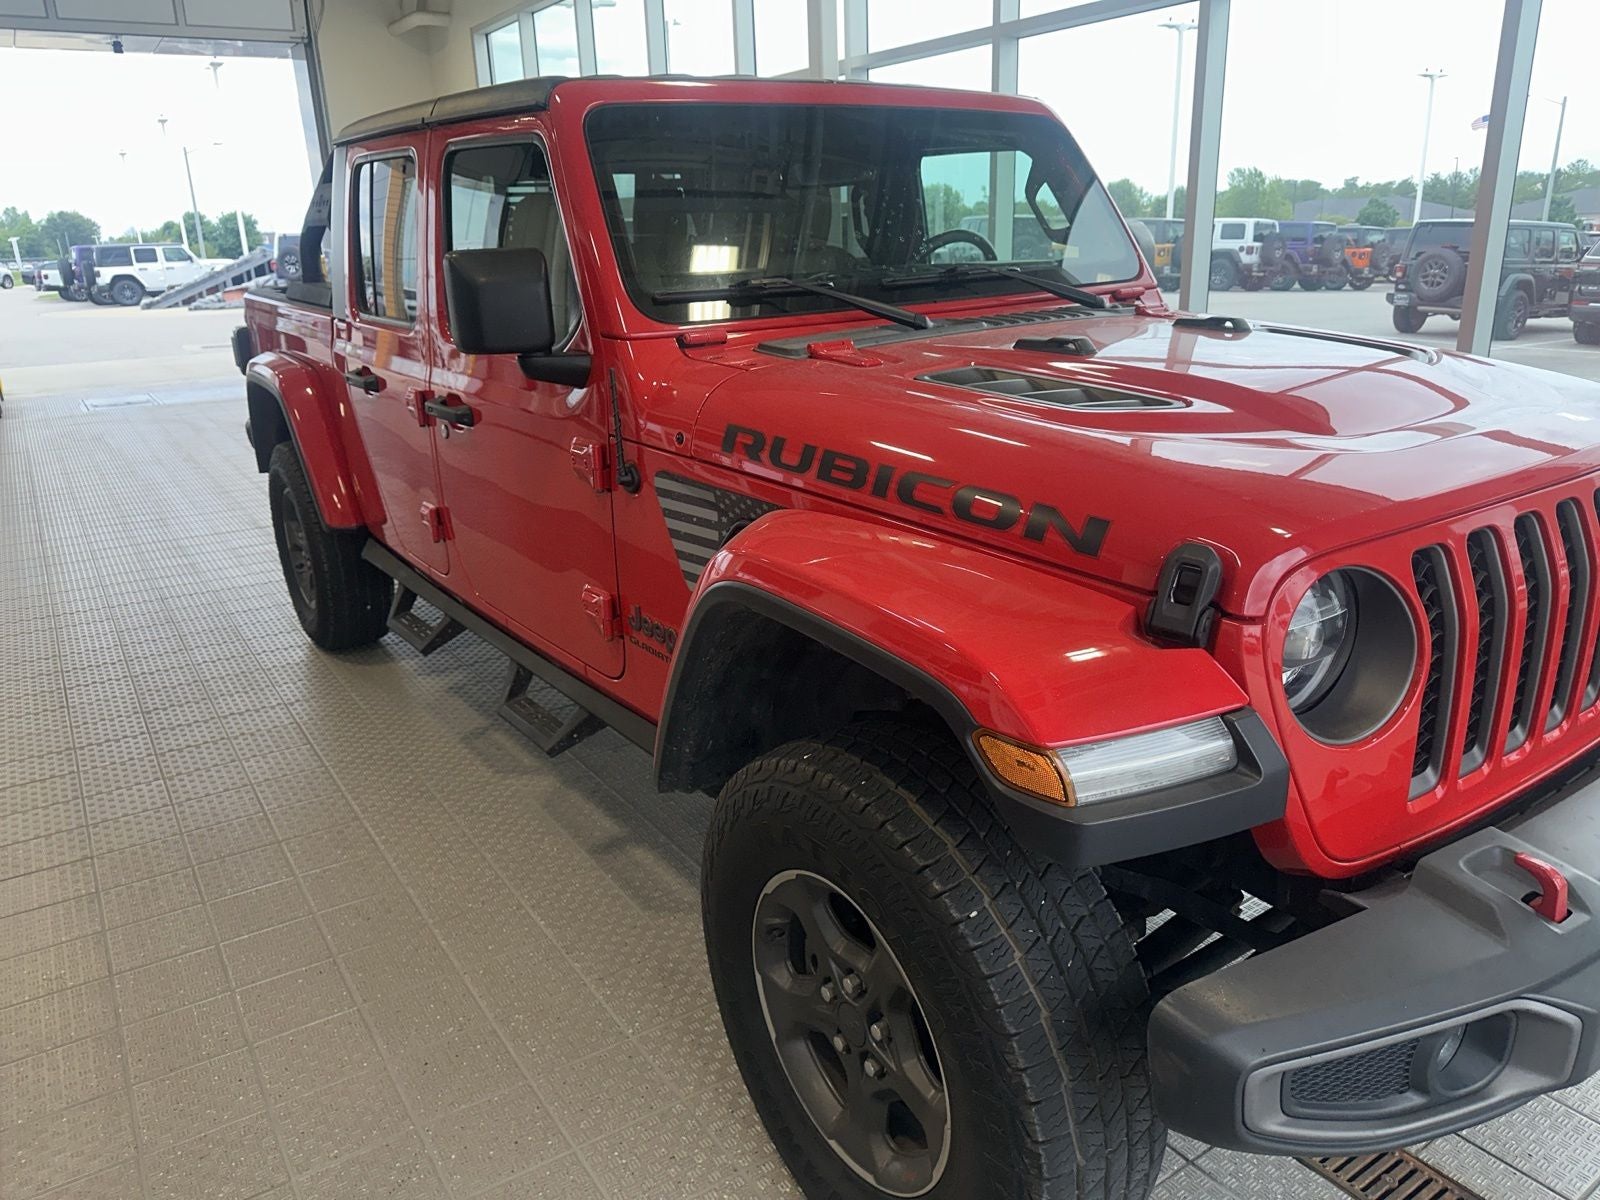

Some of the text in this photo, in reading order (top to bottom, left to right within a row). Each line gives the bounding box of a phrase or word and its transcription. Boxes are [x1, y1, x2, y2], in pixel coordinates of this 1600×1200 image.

[721, 423, 1111, 557] RUBICON
[628, 604, 677, 654] Jeep
[629, 635, 671, 664] GLADIAT
